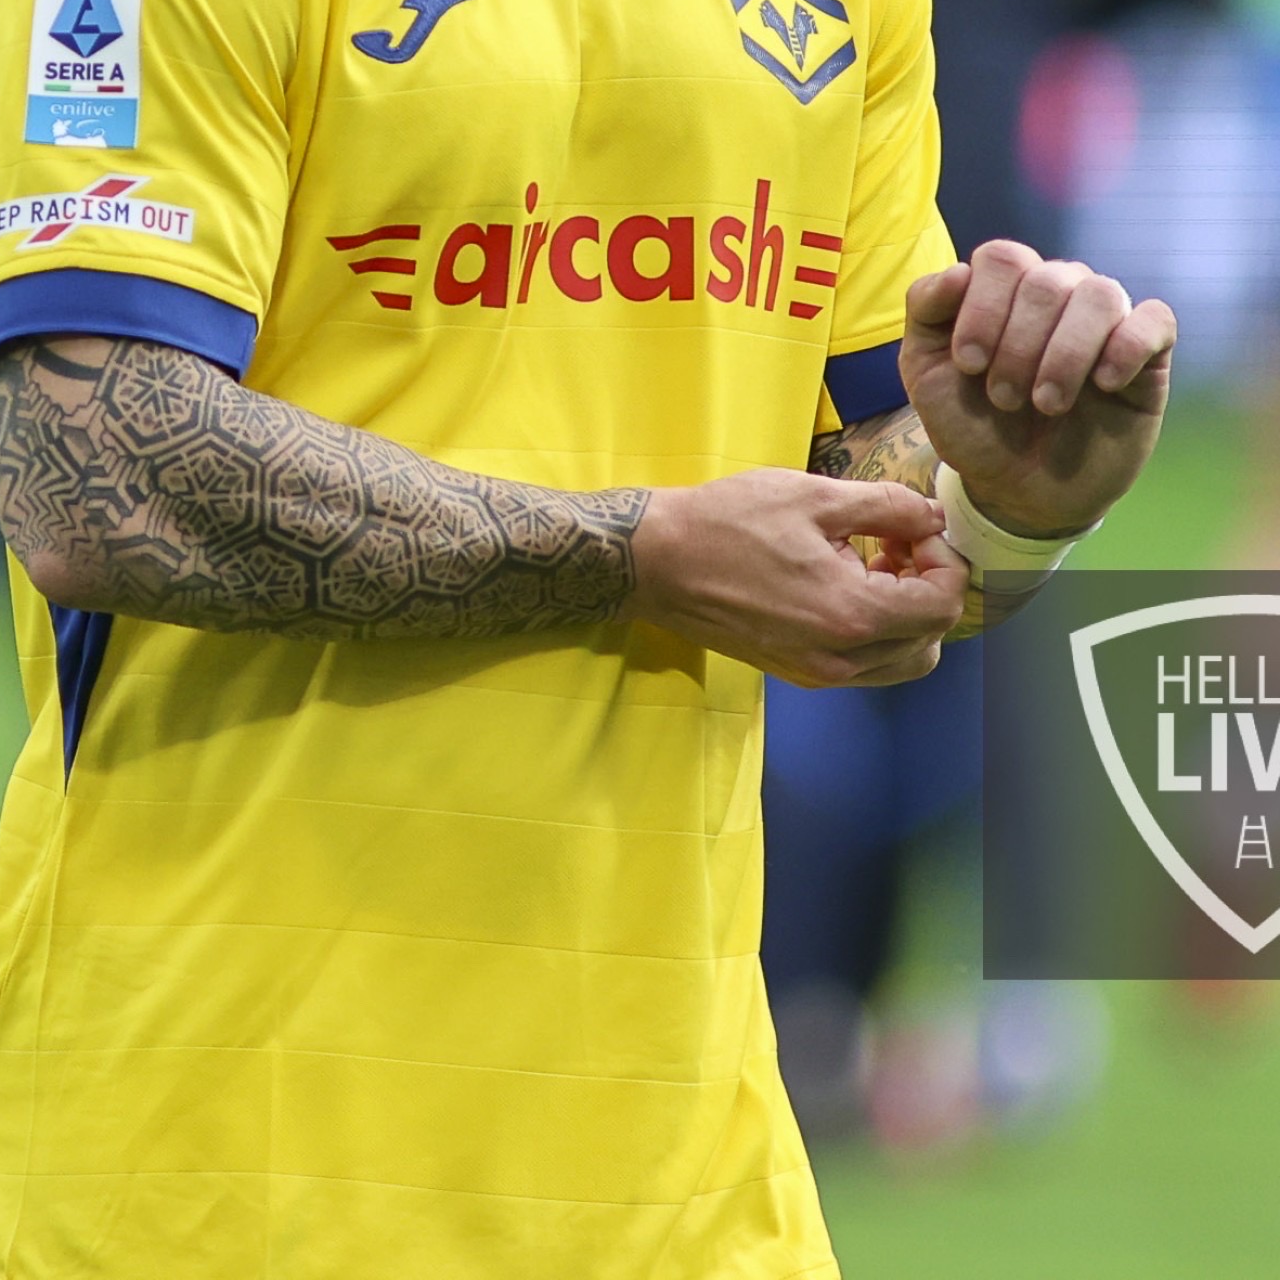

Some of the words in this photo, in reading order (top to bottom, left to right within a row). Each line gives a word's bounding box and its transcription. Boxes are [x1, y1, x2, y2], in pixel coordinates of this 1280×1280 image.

[44, 61, 105, 81] SERIE
[109, 62, 125, 82] A
[50, 101, 116, 117] enilive
[30, 197, 130, 224] RACISM
[141, 205, 190, 235] OUT
[433, 178, 785, 312] aircash
